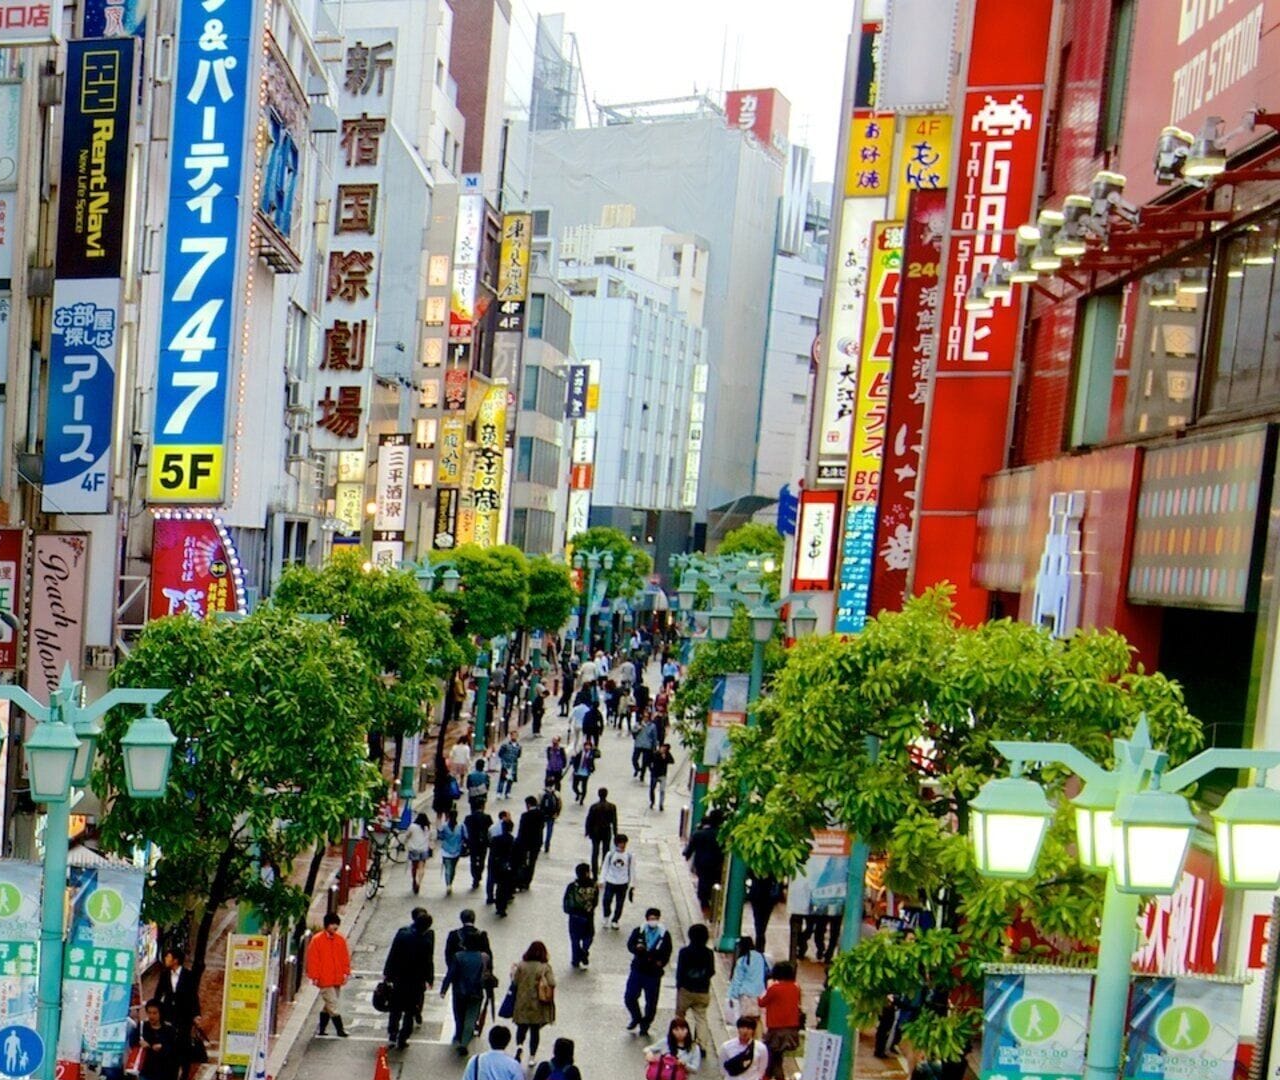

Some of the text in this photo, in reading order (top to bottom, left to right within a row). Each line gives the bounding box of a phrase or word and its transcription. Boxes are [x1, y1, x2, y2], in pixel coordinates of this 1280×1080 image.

[1170, 3, 1264, 127] TAITO STATION
[917, 120, 941, 136] 4F
[162, 0, 238, 435] &パーティ 747
[315, 41, 394, 438] 新宿国際劇場
[946, 141, 981, 362] TAITO STATION
[55, 303, 115, 330] お部屋
[498, 317, 520, 329] 4F
[500, 300, 521, 315] 4F
[64, 327, 113, 348] 探しは
[59, 354, 99, 463] アース
[835, 363, 857, 424] 大江戸
[80, 472, 106, 493] 4F
[159, 453, 215, 490] 5F
[38, 550, 79, 632] Peach
